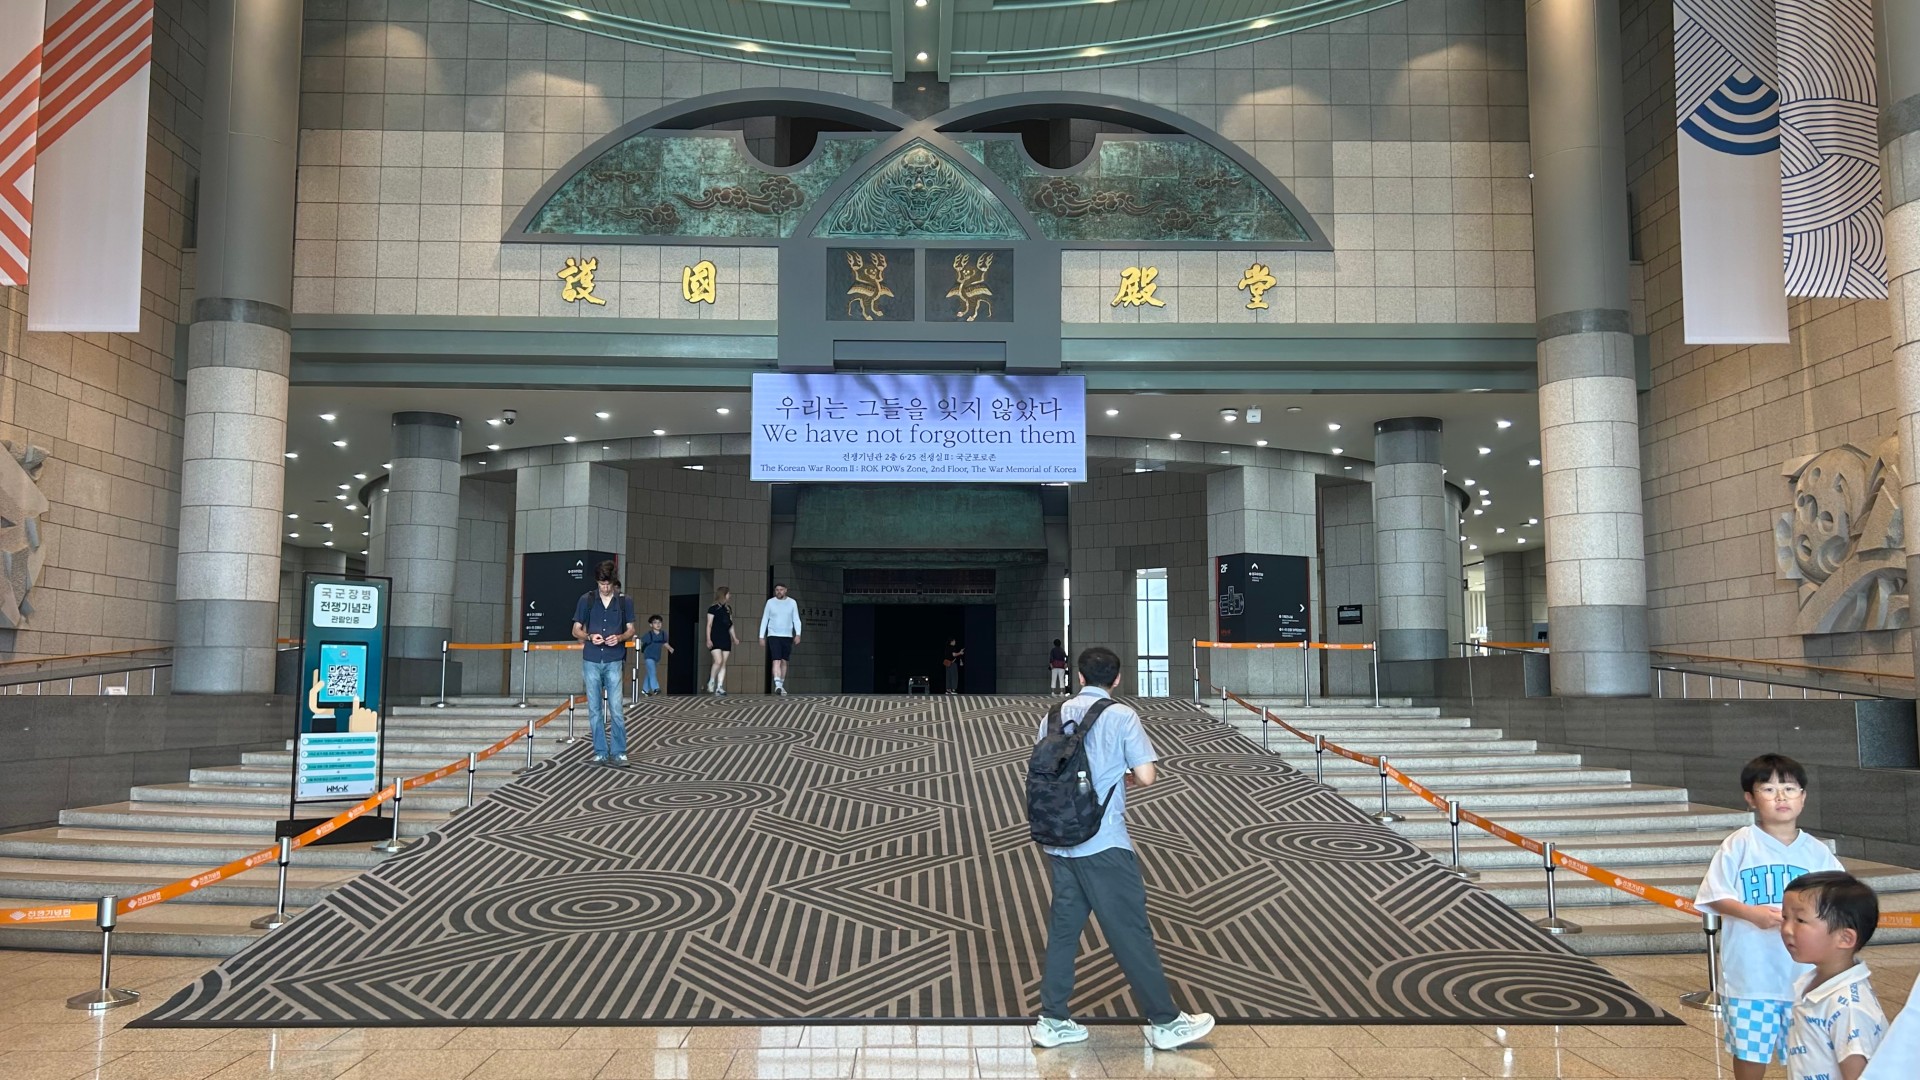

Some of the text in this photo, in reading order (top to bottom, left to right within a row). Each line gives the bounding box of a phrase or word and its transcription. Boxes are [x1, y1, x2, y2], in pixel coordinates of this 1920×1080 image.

[776, 396, 1062, 421] 우리는 그들을 잊지 않았다
[762, 423, 1077, 448] We have not forgotten them
[842, 452, 882, 462] 전쟁기념관
[760, 464, 776, 472] The
[777, 464, 806, 473] Korean
[807, 465, 824, 473] War
[825, 464, 848, 473] Room
[860, 465, 879, 473] ROK
[906, 465, 928, 474] Zone,
[930, 465, 946, 473] 2nd
[947, 465, 969, 474] Floor,
[971, 465, 987, 473] The
[988, 465, 1005, 473] War
[1006, 465, 1042, 474] Memorial
[1043, 465, 1052, 474] of
[1054, 465, 1077, 474] Korea
[320, 601, 371, 613] 전쟁기념관
[1740, 864, 1811, 905] HI
